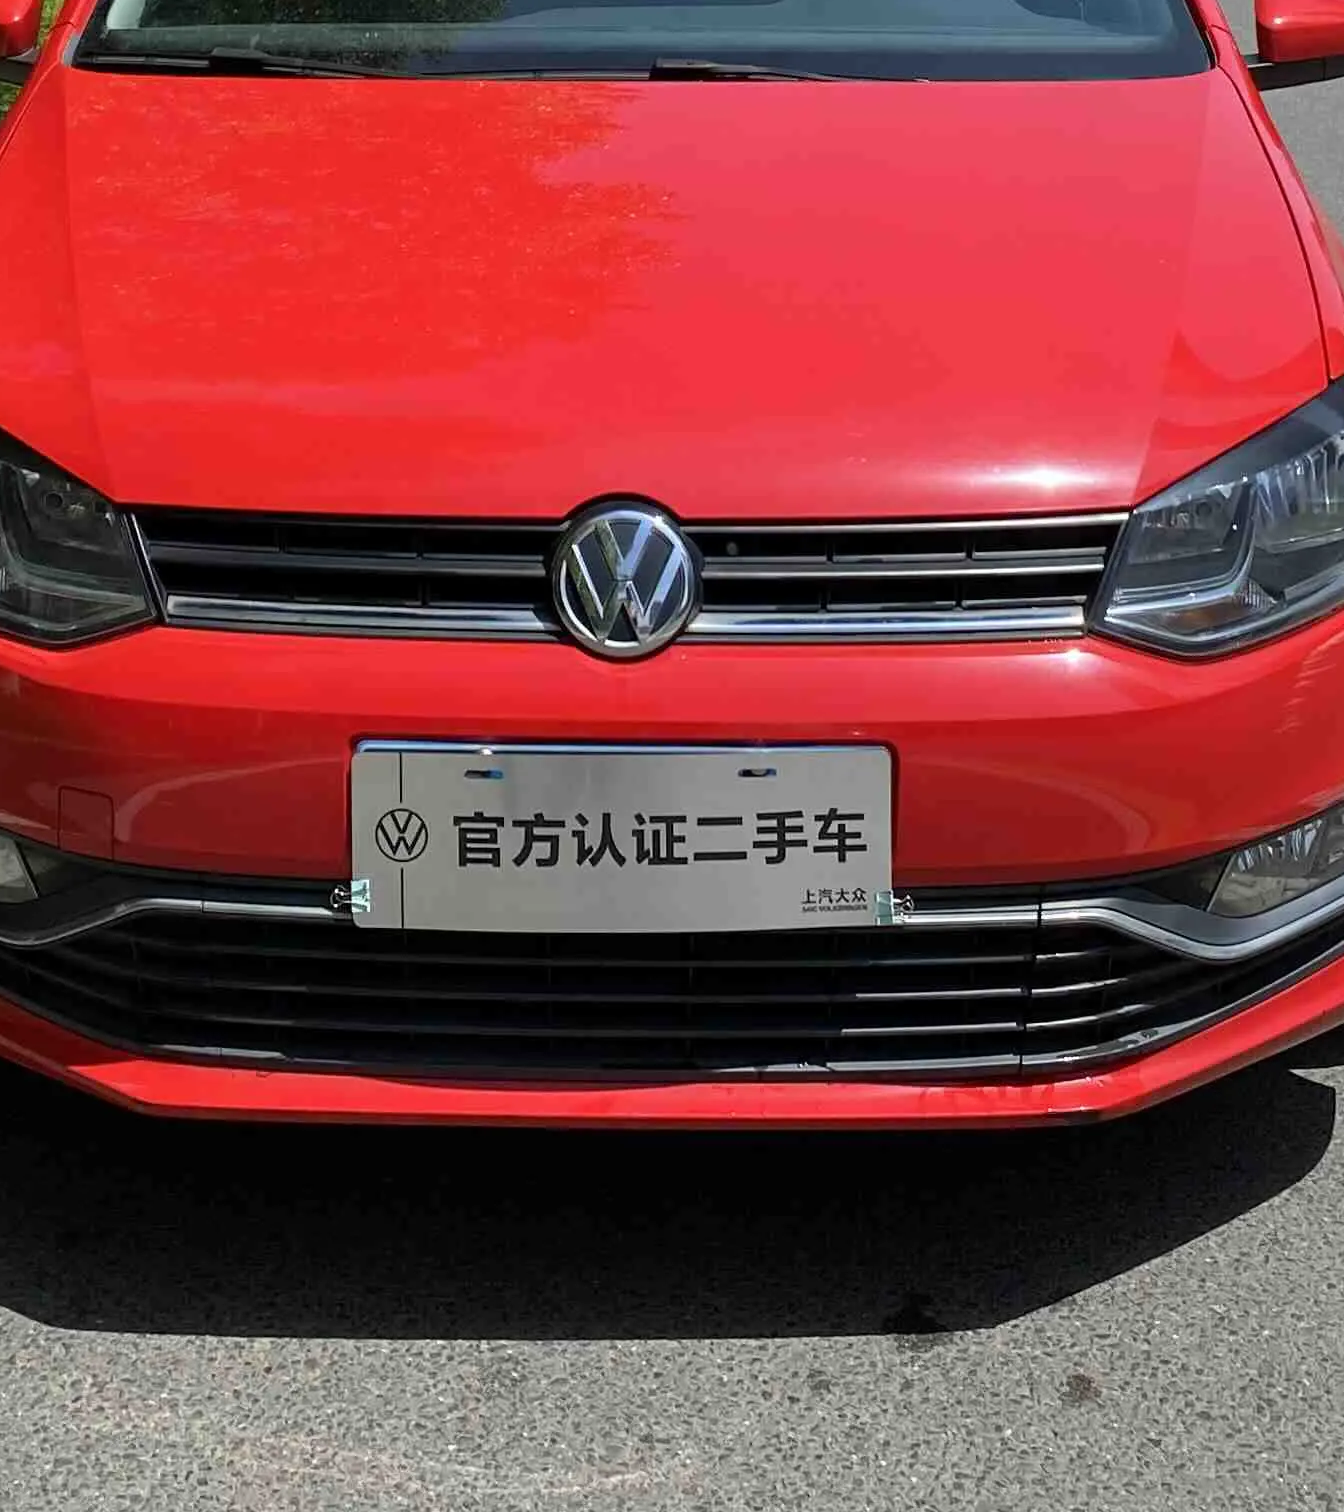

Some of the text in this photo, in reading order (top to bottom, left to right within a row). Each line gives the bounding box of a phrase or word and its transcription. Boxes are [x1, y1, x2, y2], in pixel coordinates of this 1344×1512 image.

[452, 807, 869, 869] 官方认证二手车
[801, 887, 868, 905] 上汽大众
